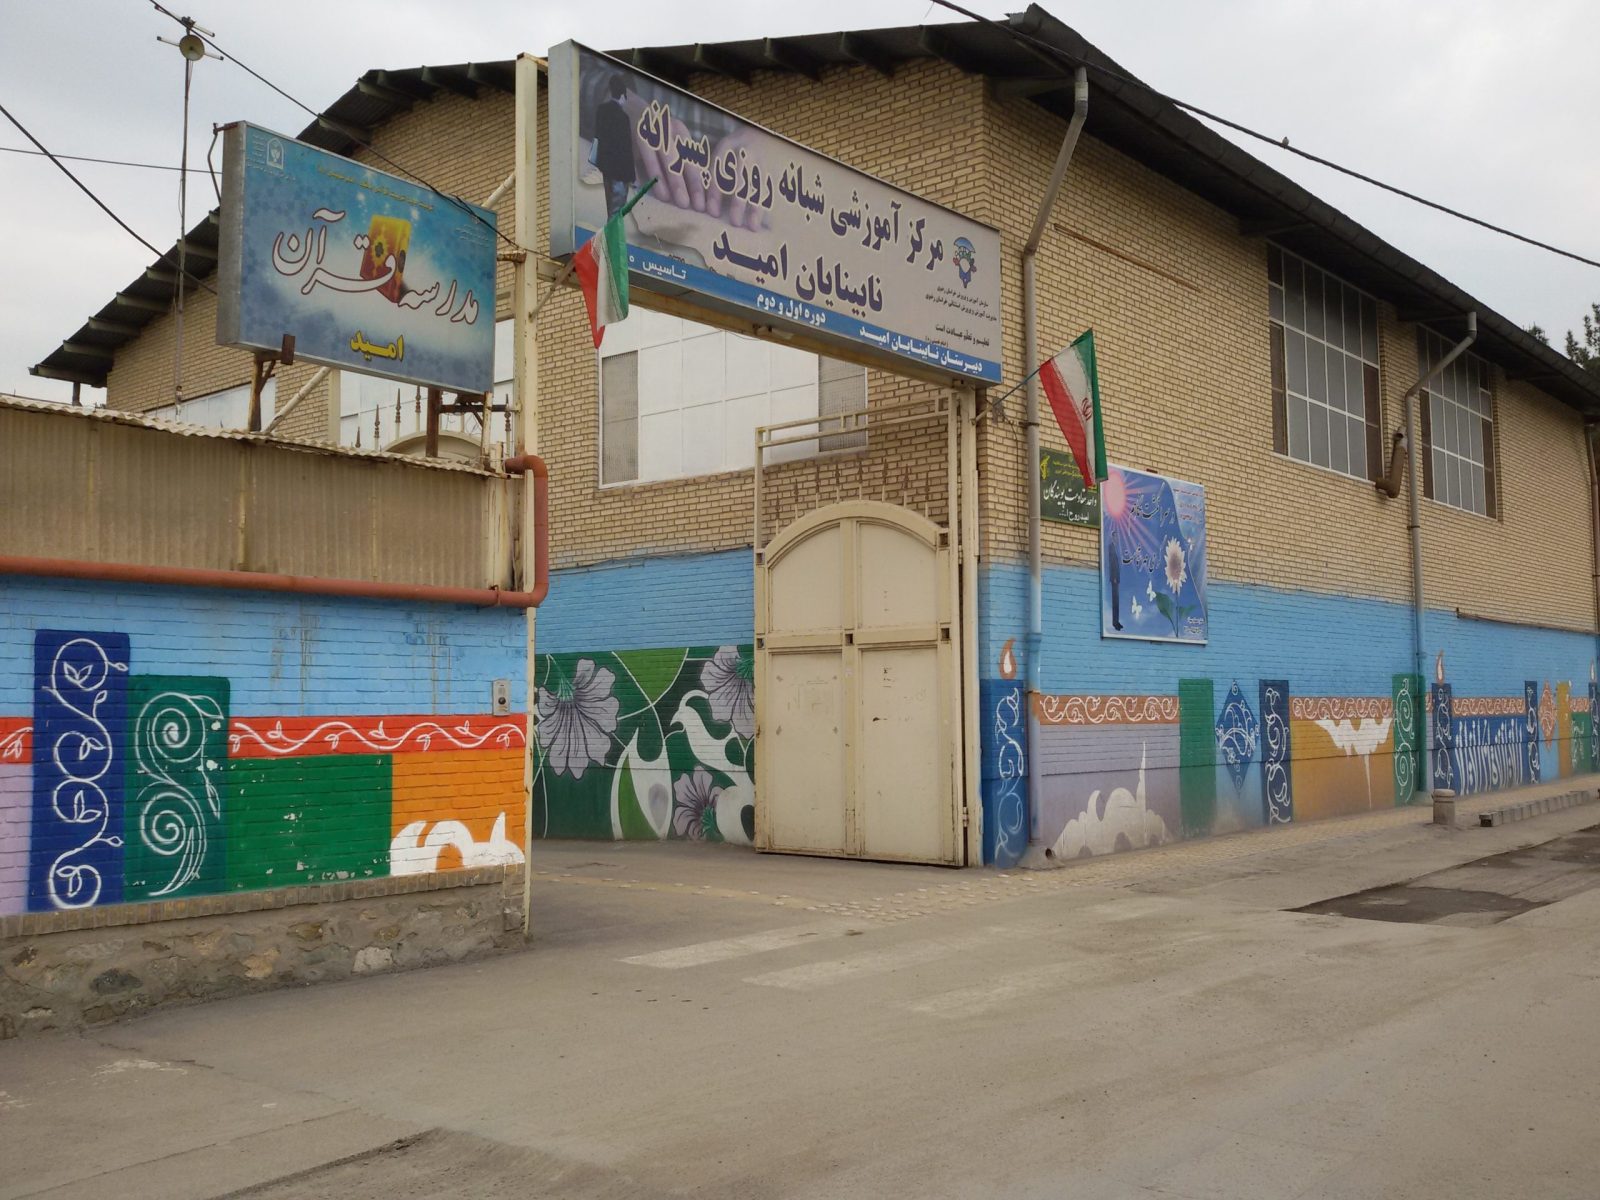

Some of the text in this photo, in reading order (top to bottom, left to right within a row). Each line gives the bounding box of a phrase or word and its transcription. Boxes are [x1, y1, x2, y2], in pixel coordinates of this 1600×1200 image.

[637, 100, 944, 271] مرکز آموزشی شبانه روزی پسرانه
[271, 207, 398, 296] قرآن
[642, 261, 687, 280] تاسیس
[713, 231, 883, 318] نابینایان امید
[756, 293, 827, 327] دوره اول و دوم
[350, 330, 404, 361] امید
[859, 325, 890, 346] امید
[891, 335, 939, 360] نابینایان
[941, 350, 983, 374] دبیرستان
